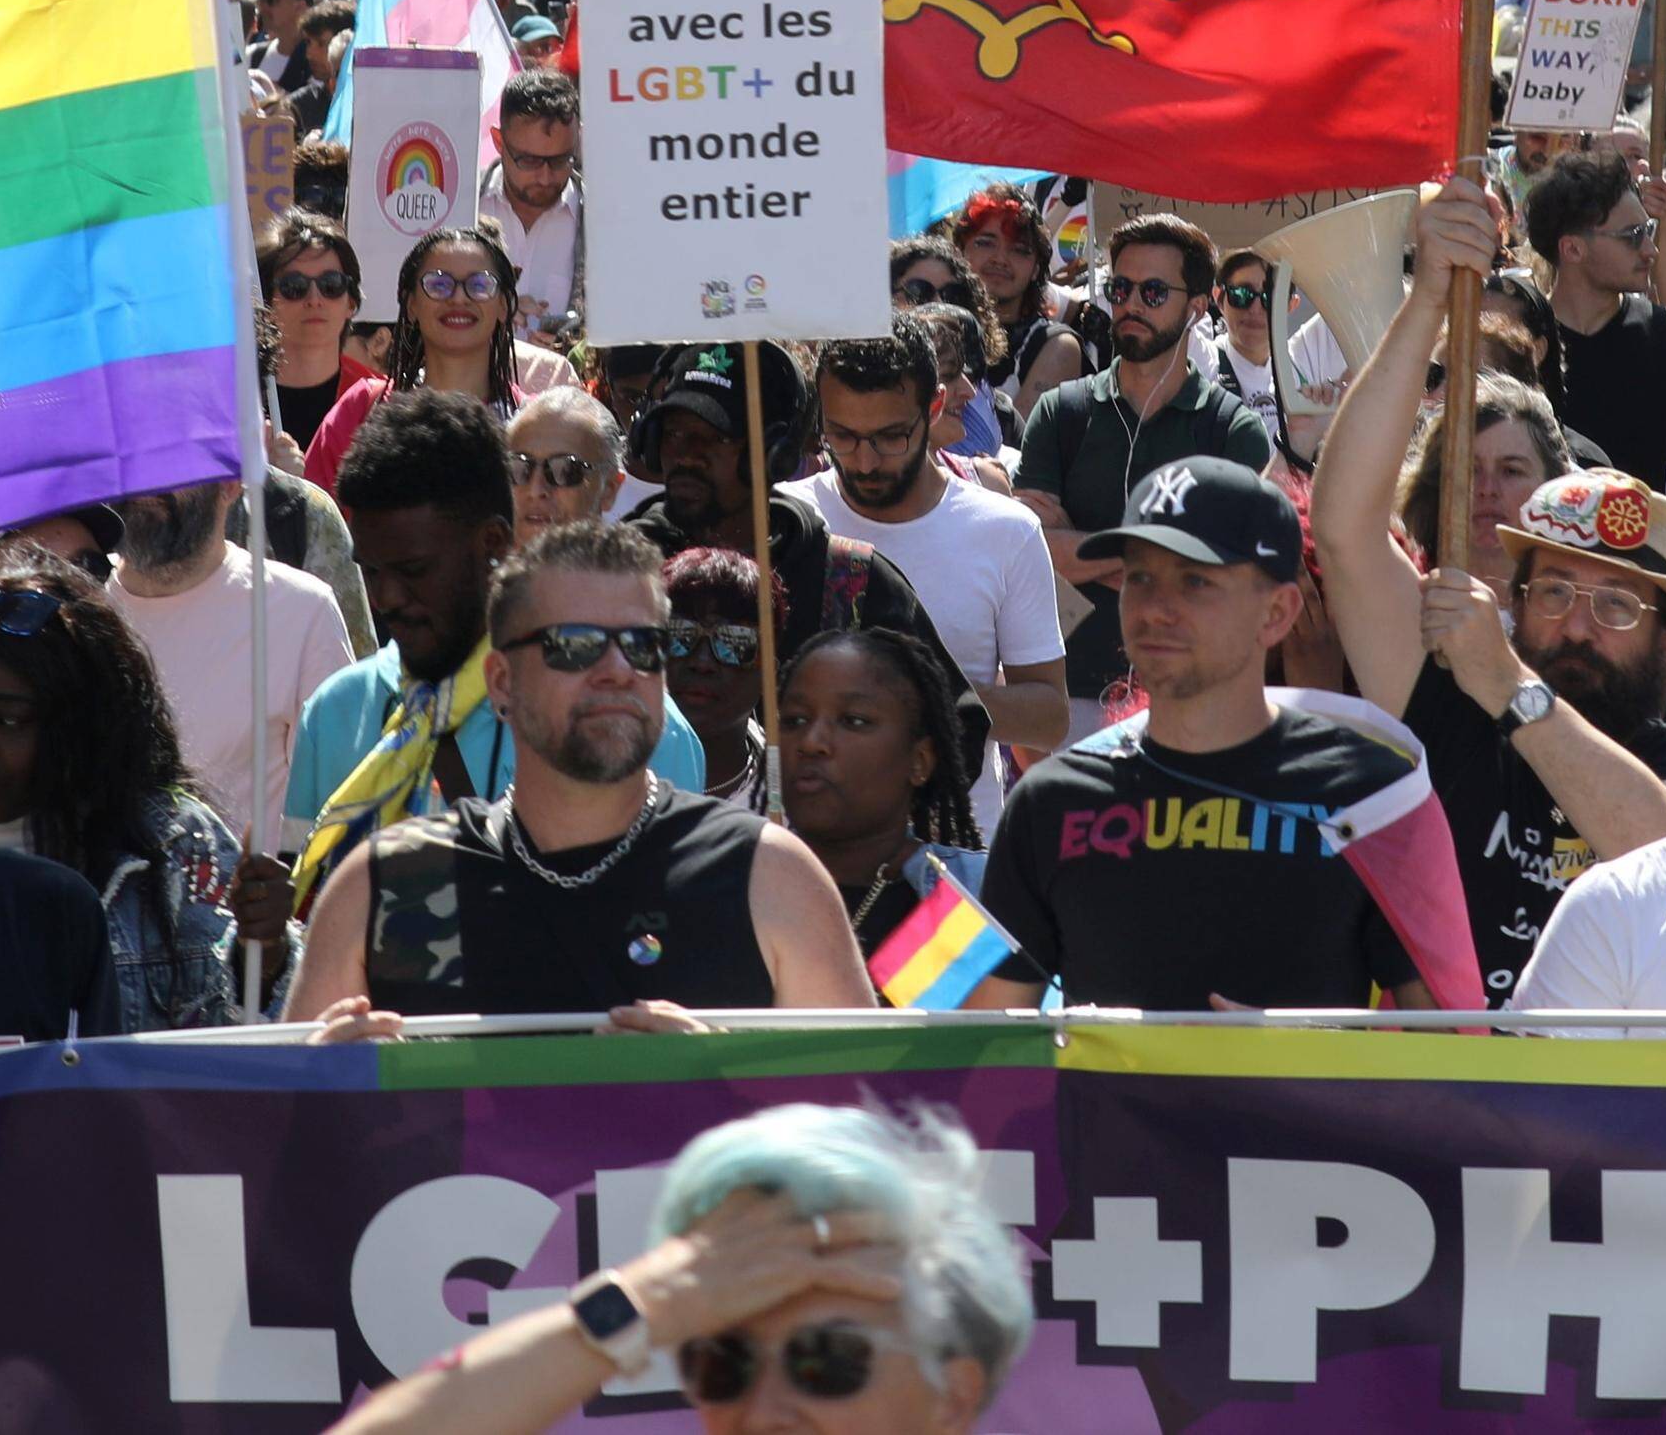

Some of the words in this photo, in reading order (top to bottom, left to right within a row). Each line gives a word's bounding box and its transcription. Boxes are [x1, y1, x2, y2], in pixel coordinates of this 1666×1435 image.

[628, 11, 745, 42] avec
[762, 3, 832, 38] les
[1538, 18, 1601, 38] THIS
[1532, 49, 1596, 75] WAY,
[608, 65, 774, 103] LGBT+
[795, 61, 856, 97] du
[1523, 80, 1585, 105] baby
[649, 122, 820, 162] monde
[397, 193, 437, 221] QUEER
[660, 183, 811, 221] entier
[1059, 797, 1346, 860] EQUALITY
